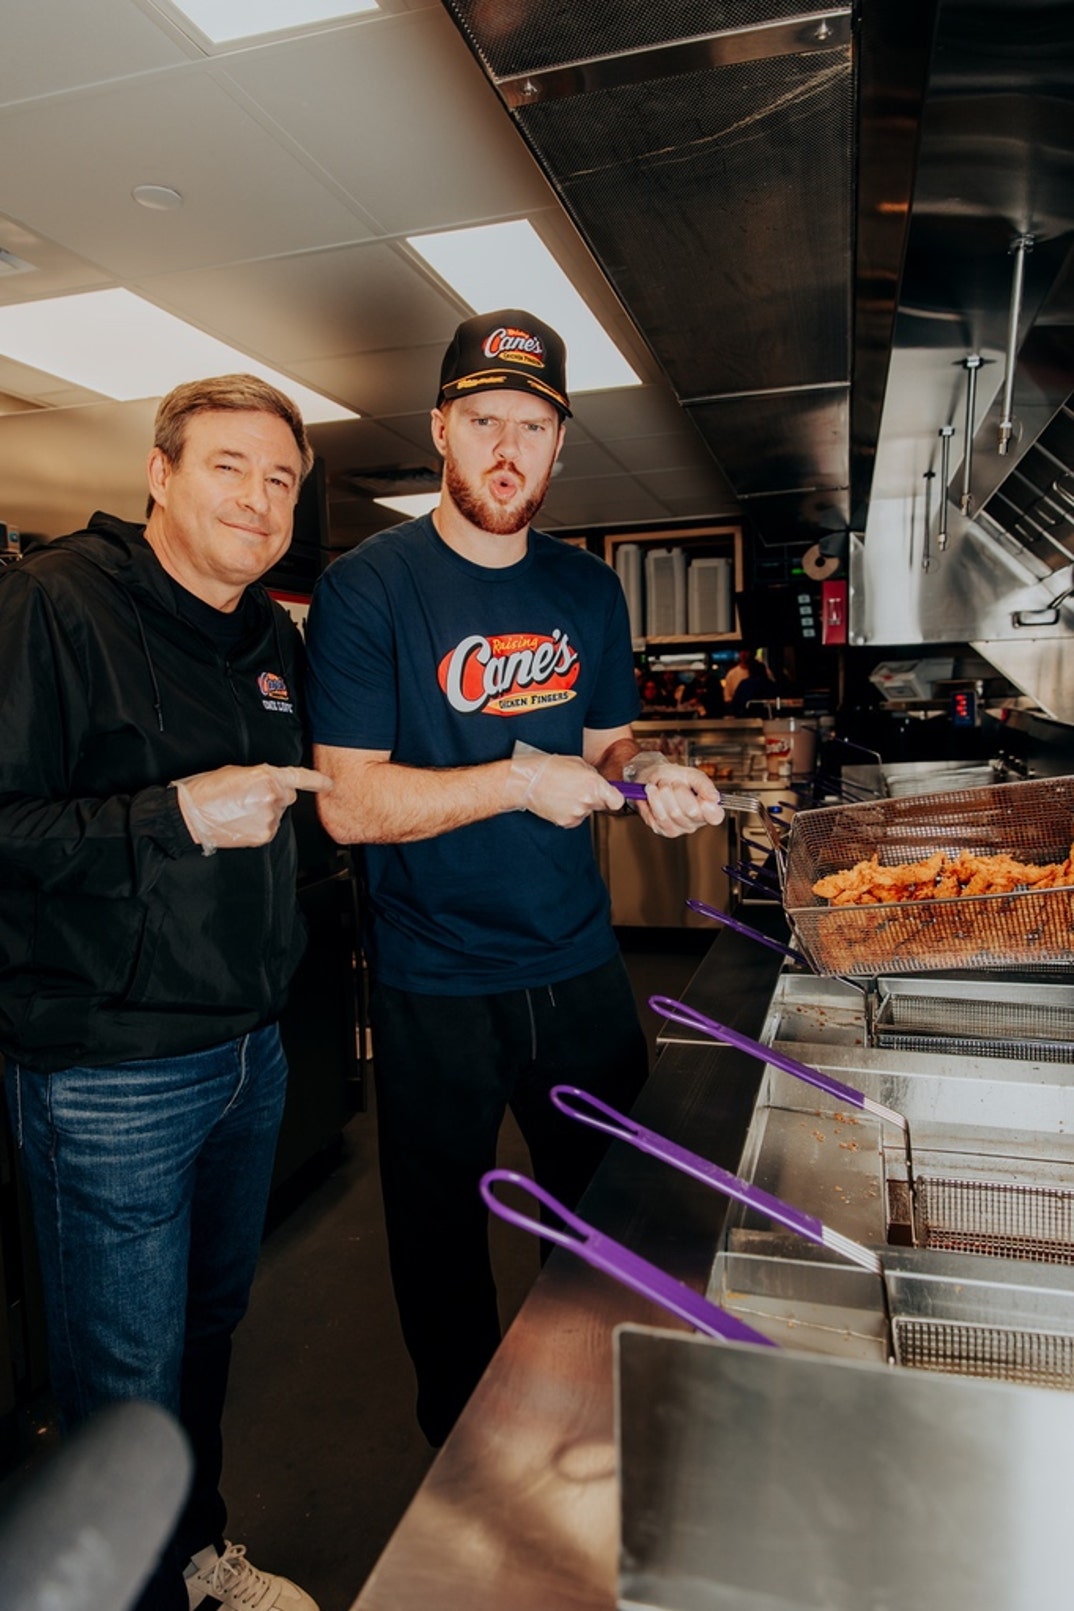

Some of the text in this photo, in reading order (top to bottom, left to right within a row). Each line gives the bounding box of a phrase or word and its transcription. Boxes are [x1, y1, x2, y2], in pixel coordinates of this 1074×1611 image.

[484, 328, 543, 358] Cane's
[492, 636, 538, 653] Raising
[446, 629, 577, 713] Cane's
